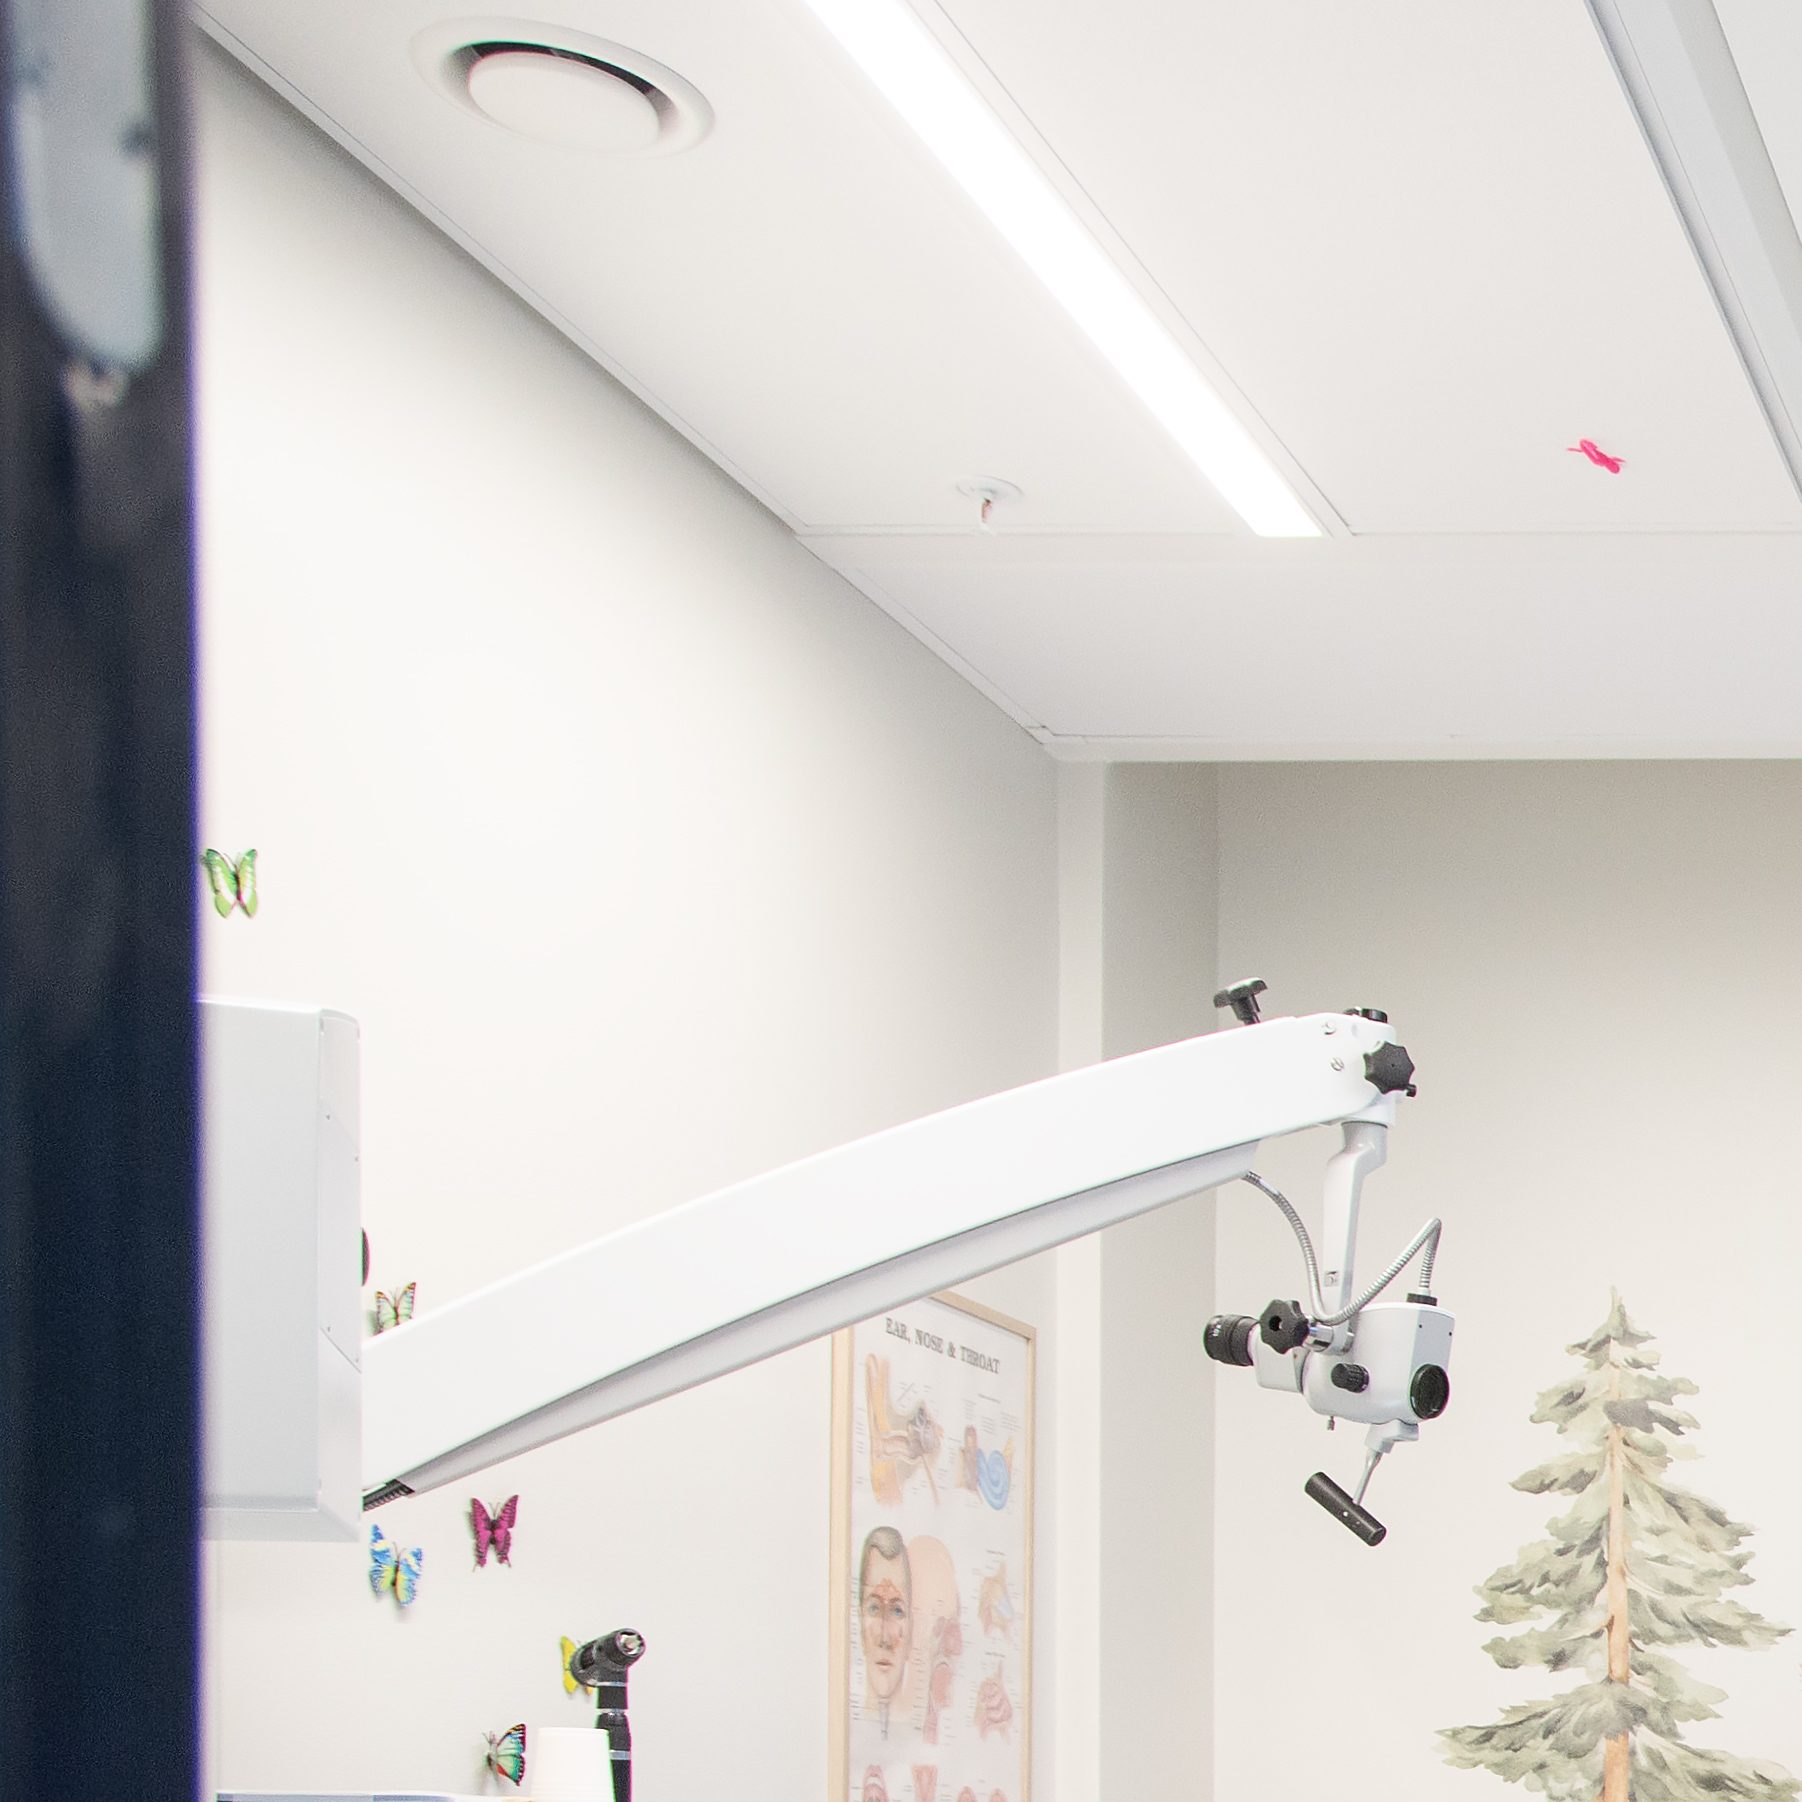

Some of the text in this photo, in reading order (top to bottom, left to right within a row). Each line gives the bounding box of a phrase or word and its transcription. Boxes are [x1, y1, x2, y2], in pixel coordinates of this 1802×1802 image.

[885, 1316, 1000, 1374] EAR, NOSE & THROAT
